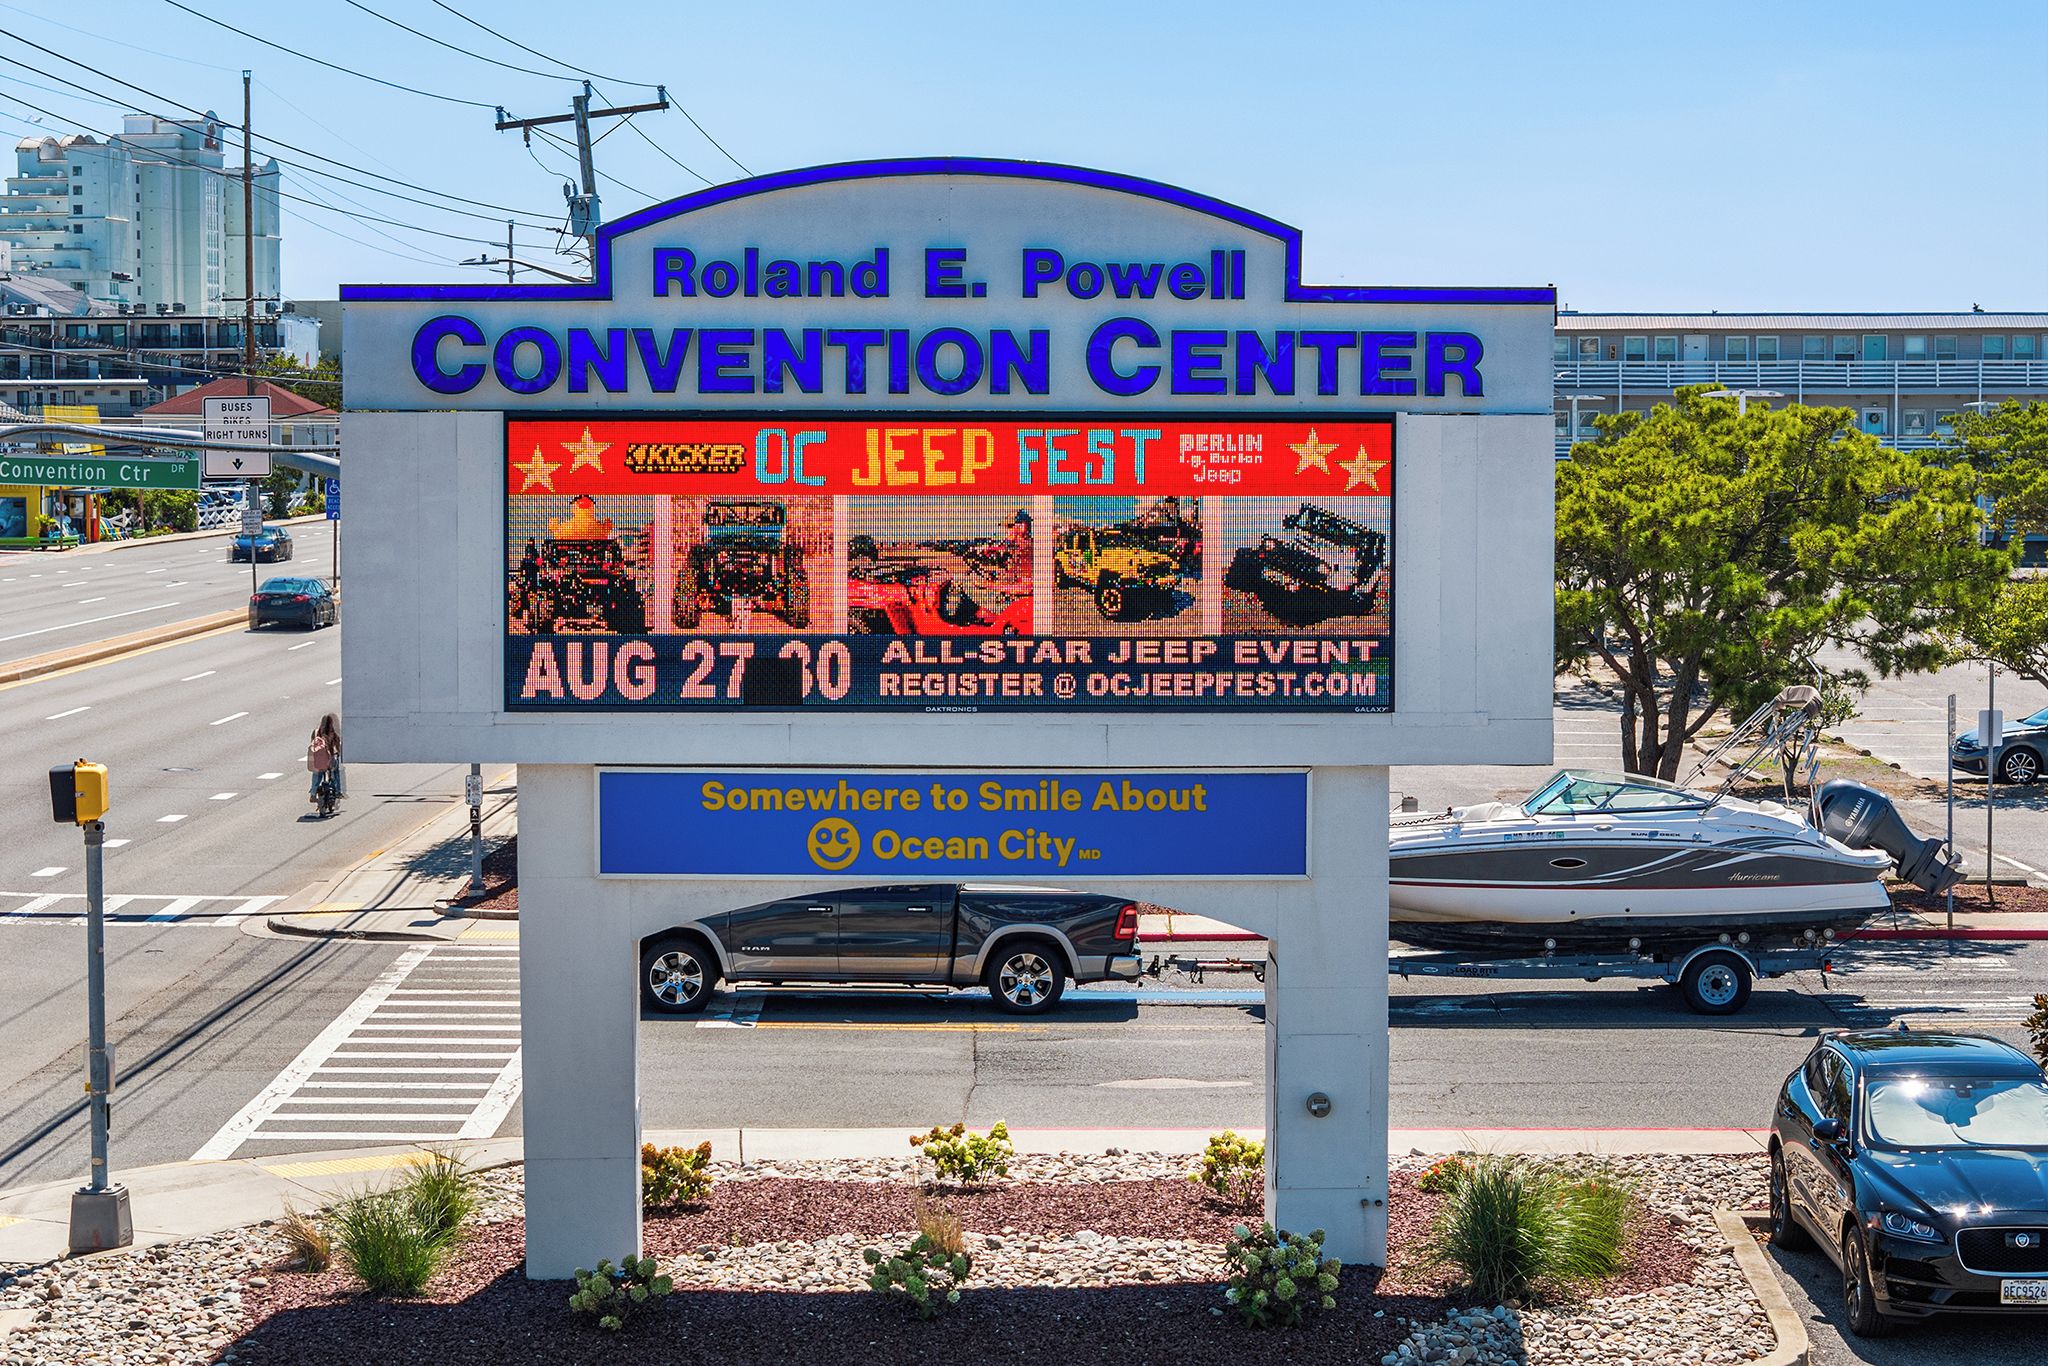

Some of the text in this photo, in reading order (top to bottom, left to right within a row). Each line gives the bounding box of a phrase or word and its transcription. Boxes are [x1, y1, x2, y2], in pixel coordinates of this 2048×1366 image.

[652, 247, 1245, 300] Roland E. Powell
[411, 315, 1484, 397] CONVENTION CENTER
[221, 402, 253, 412] BUSES
[223, 416, 251, 426] BIKES
[206, 430, 268, 440] RIGHT TURNS
[755, 428, 827, 485] OC
[852, 428, 994, 486] JEEP
[1017, 428, 1162, 486] FEST
[0, 461, 185, 482] Convention Ctr DR
[1193, 465, 1241, 485] Jeep
[882, 640, 1379, 664] ALL-STAR JEEP EVENT
[521, 641, 657, 700] AUG
[680, 640, 755, 699] 27
[880, 672, 1377, 700] REGISTER @ OCJEEPFEST.COM
[701, 780, 1207, 812] Somewhere to Smile About
[1848, 797, 1867, 821] YAMAHA
[872, 828, 989, 861] Ocean
[998, 827, 1076, 868] City
[1079, 848, 1101, 860] MD
[1728, 871, 1781, 881] Hurricane
[1455, 966, 1478, 974] LOAD
